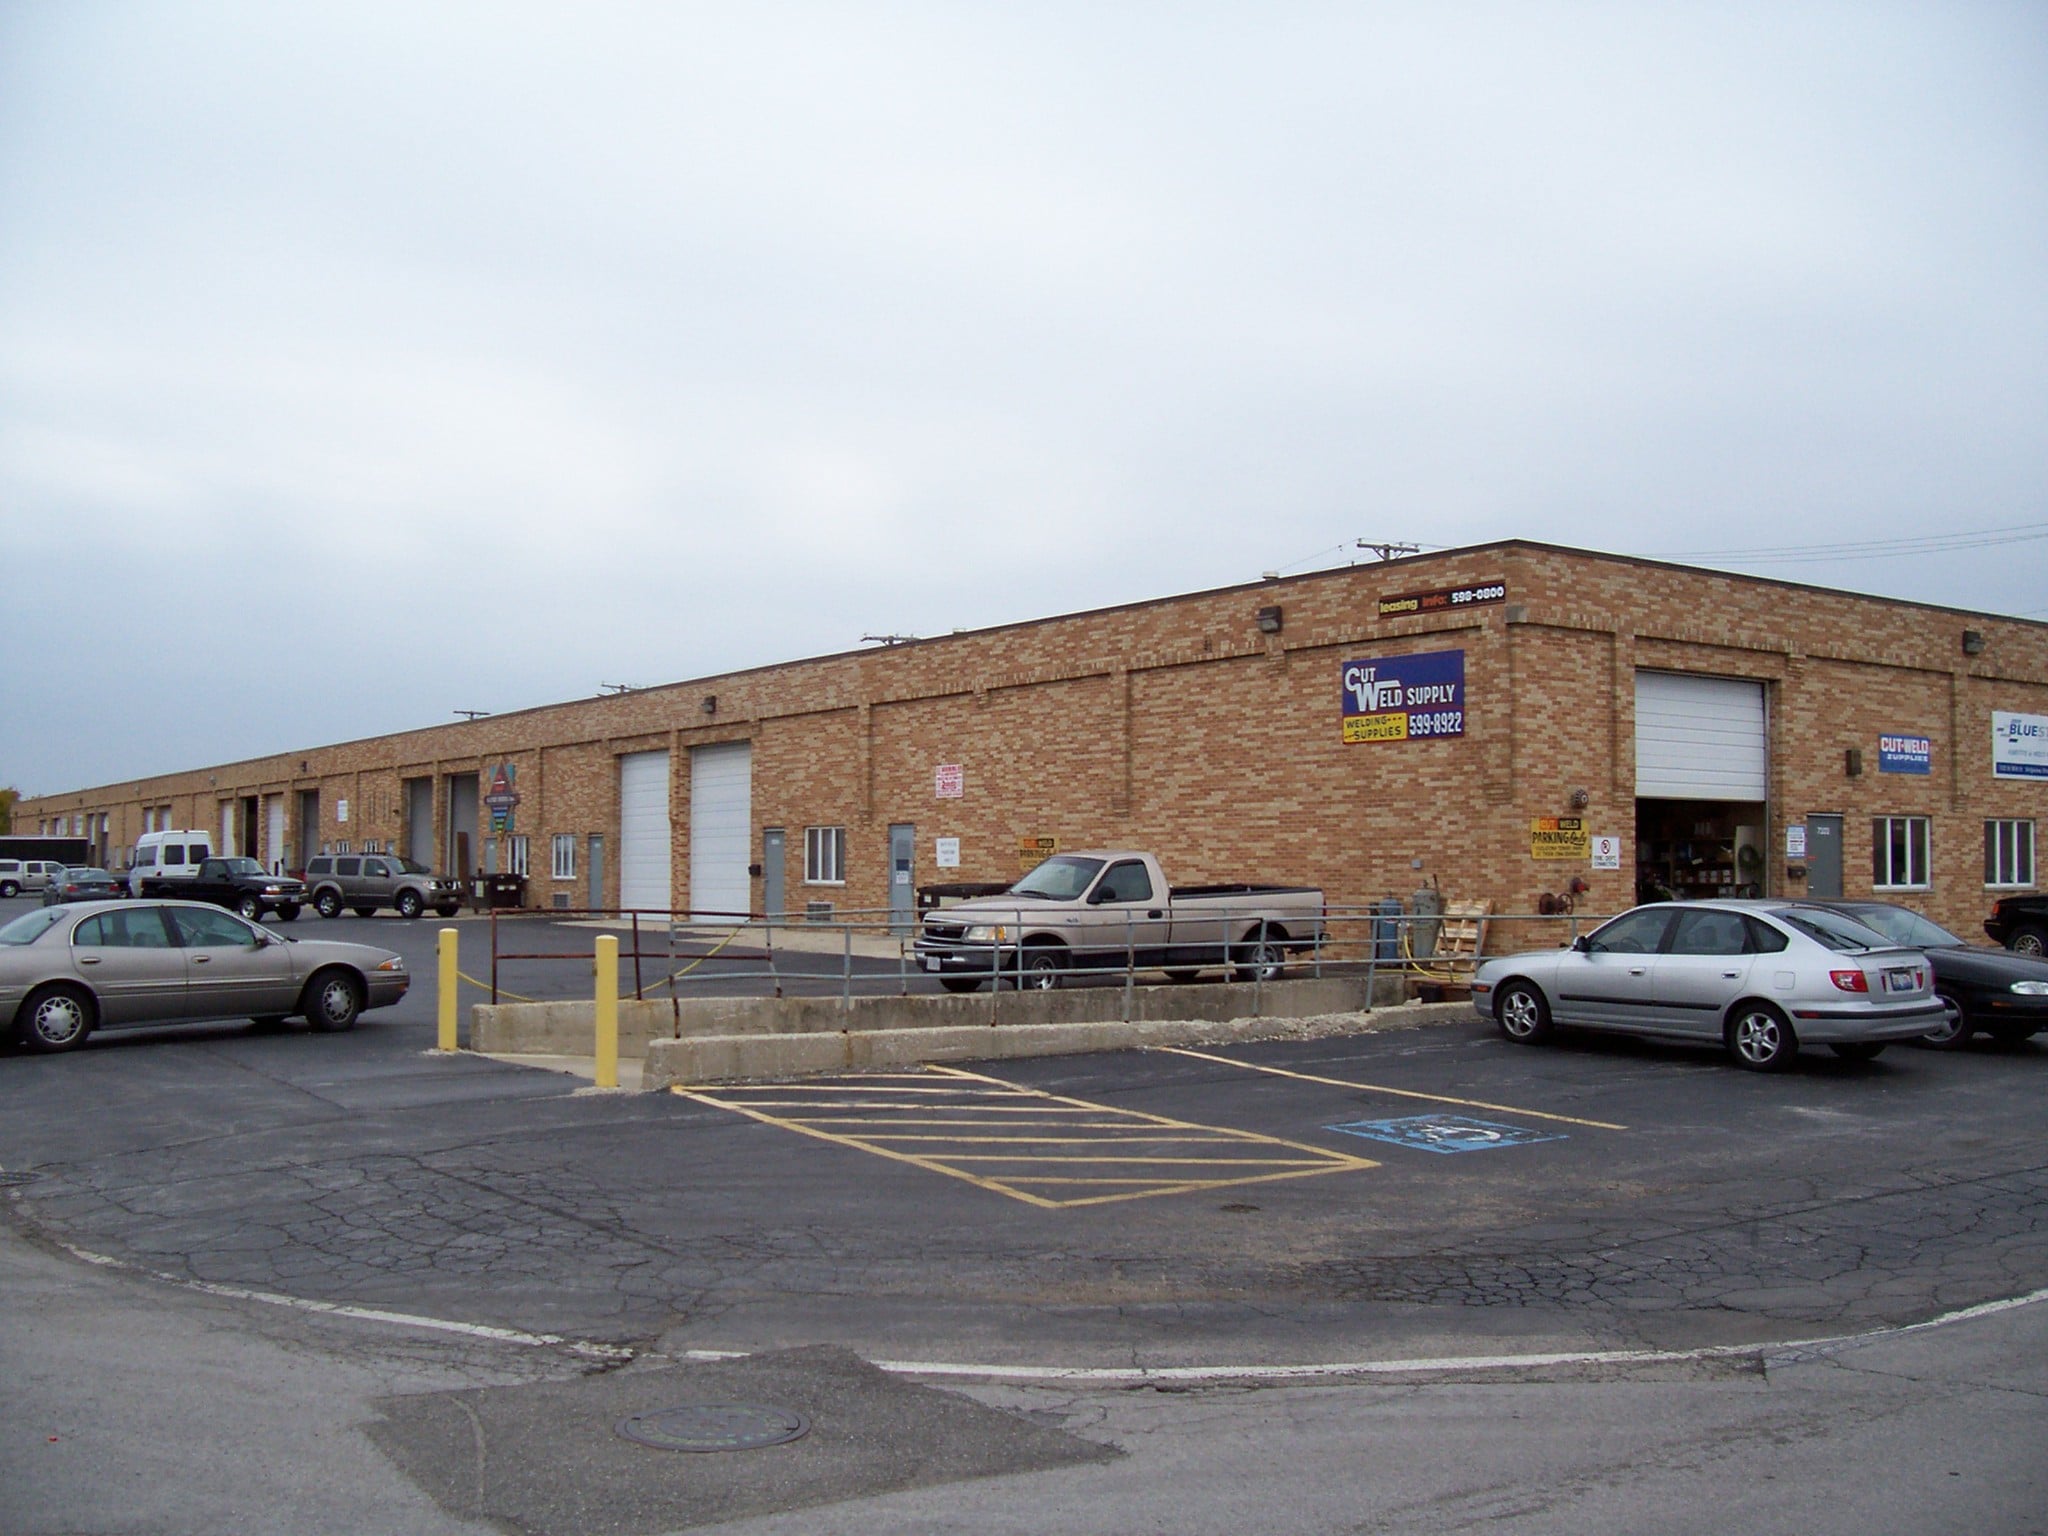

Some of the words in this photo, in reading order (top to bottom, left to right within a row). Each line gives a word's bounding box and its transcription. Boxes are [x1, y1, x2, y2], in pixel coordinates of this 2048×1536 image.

[1380, 599, 1418, 613] leasing
[1451, 586, 1505, 603] 598-0800
[1345, 667, 1376, 692] CUT
[1356, 680, 1403, 712] WELD
[1407, 684, 1455, 706] SUPPLY
[1409, 712, 1462, 736] 599-8922
[1532, 831, 1569, 844] PARKING
